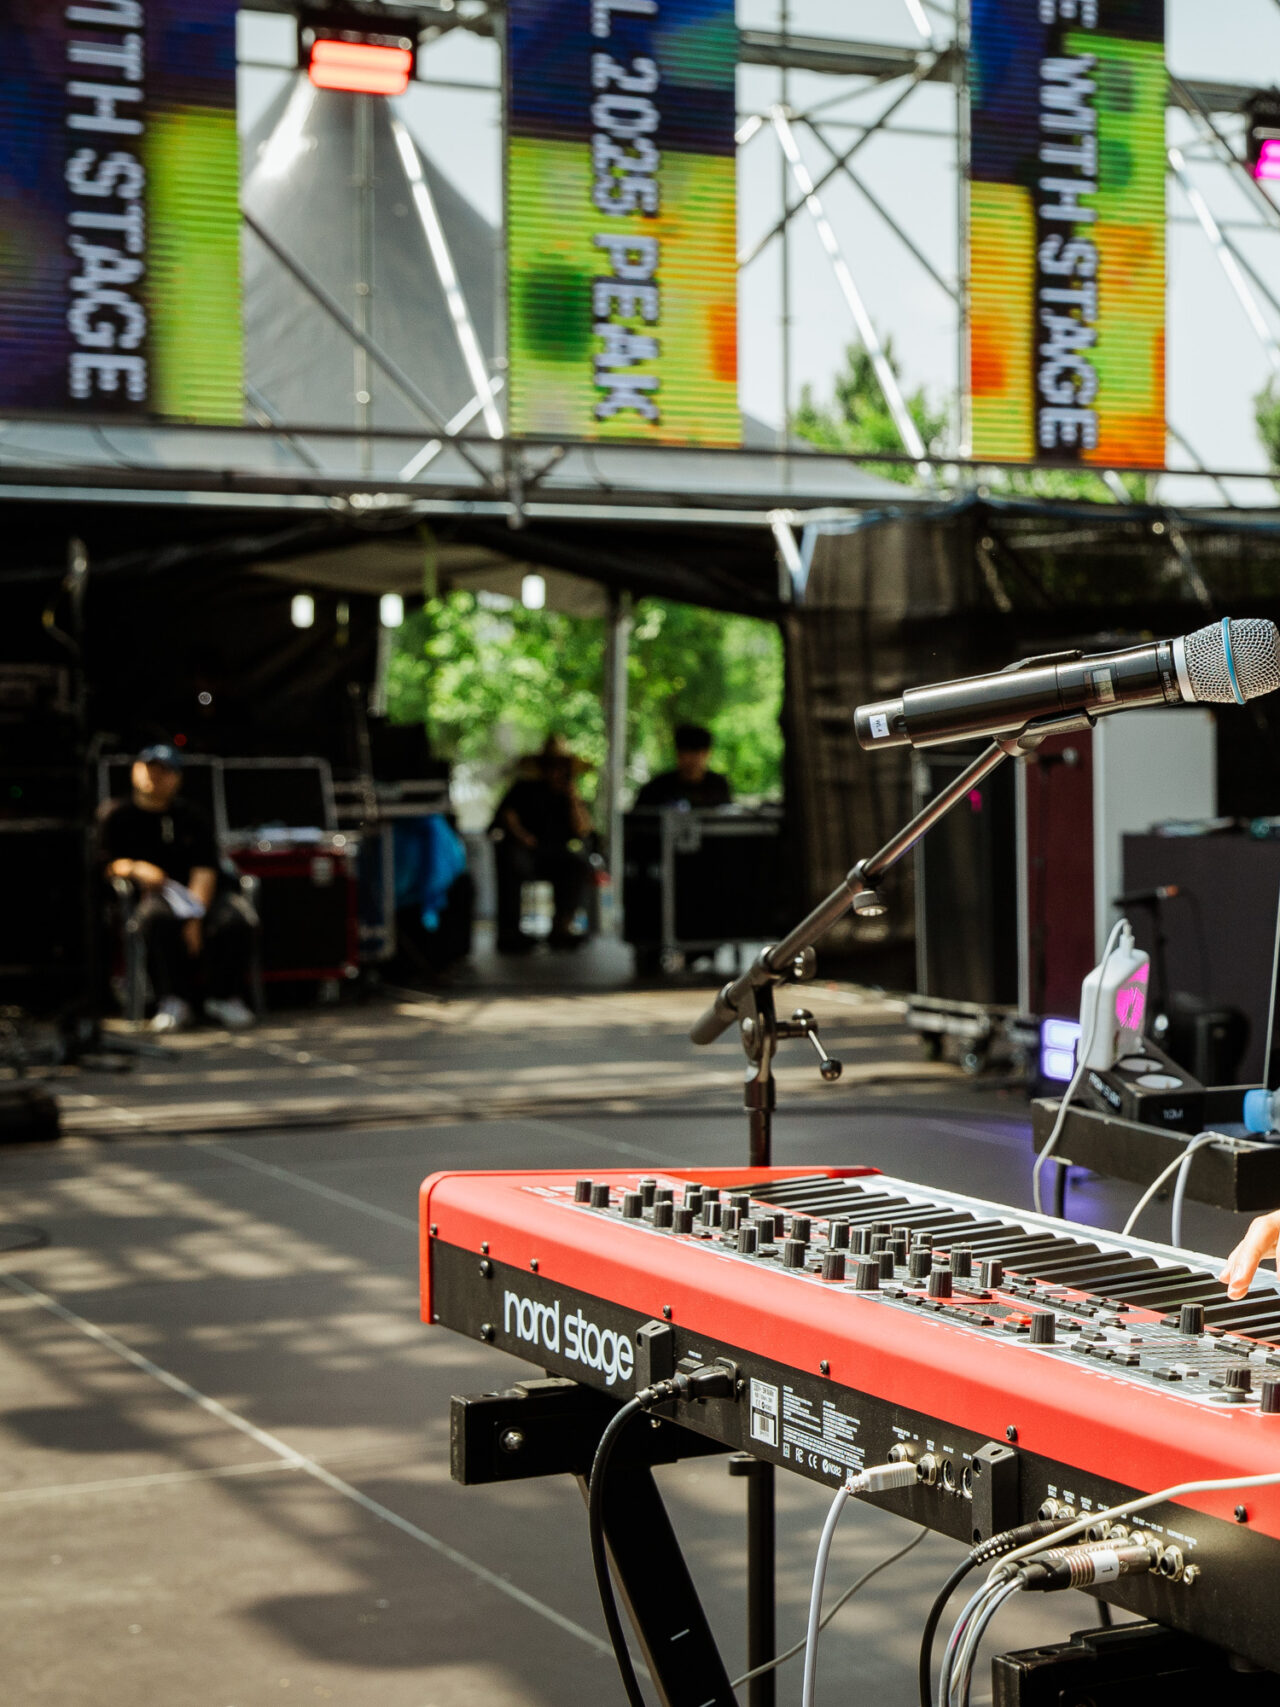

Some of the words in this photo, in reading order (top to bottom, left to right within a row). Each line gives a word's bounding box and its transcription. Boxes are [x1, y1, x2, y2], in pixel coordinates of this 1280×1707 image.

[590, 52, 661, 218] 2025
[1038, 53, 1098, 223] WITH
[66, 147, 147, 403] STAGE
[593, 233, 661, 424] PEAK
[1037, 234, 1098, 450] STAGE
[504, 1290, 560, 1354] nord
[564, 1308, 634, 1386] stage
